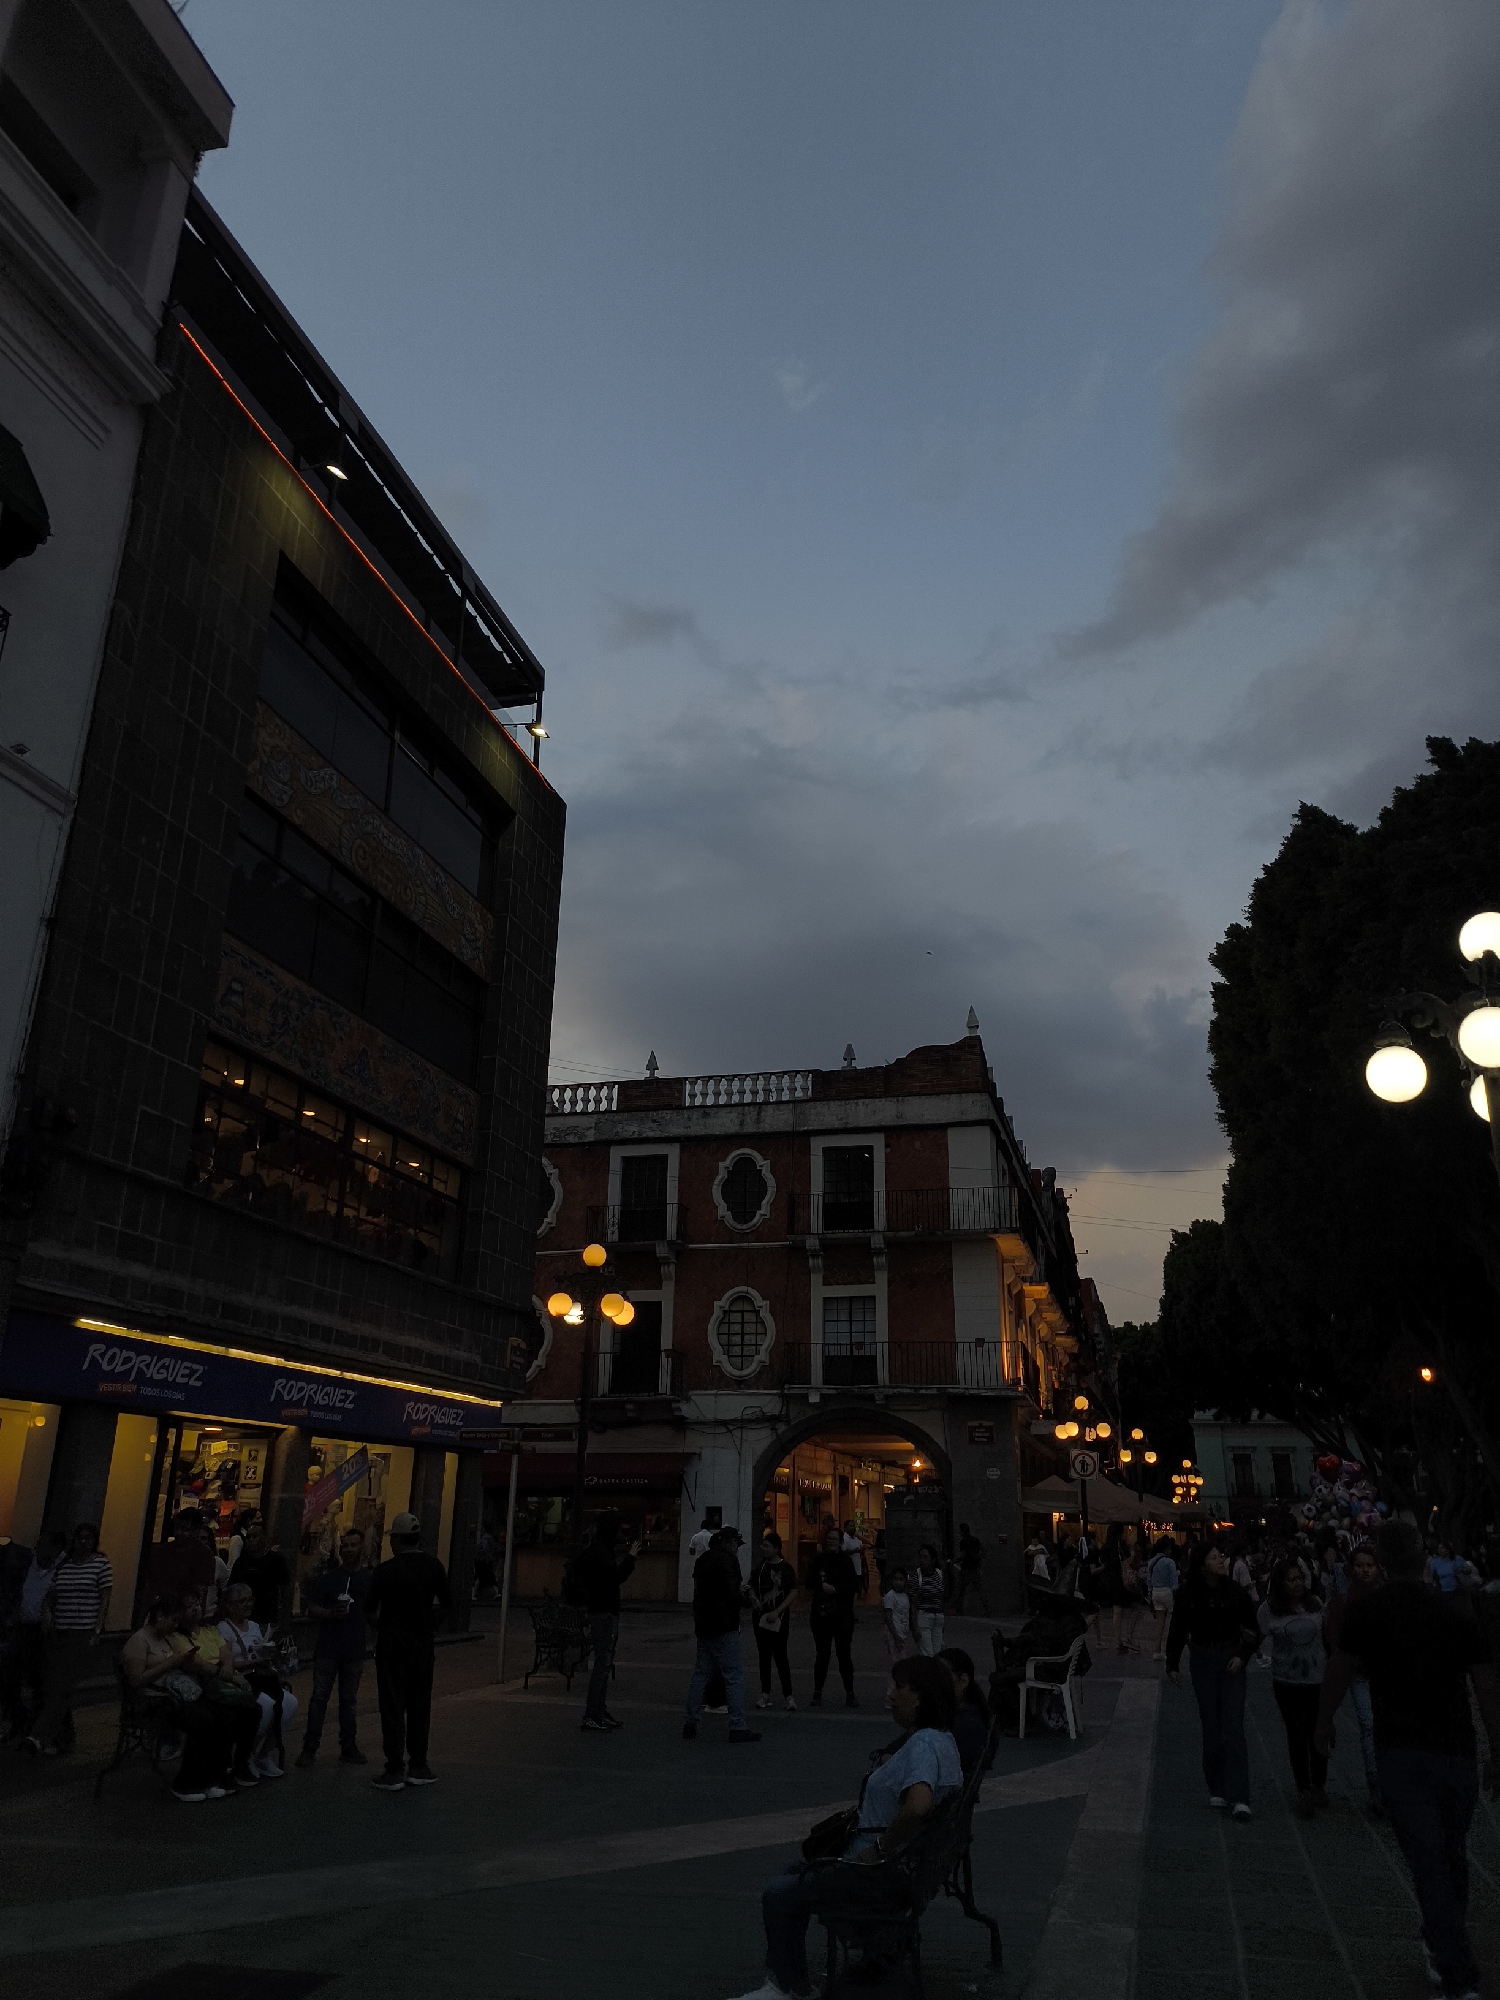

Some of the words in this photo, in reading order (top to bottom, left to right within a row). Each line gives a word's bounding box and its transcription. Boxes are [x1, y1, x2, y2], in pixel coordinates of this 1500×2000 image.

[82, 1343, 203, 1387] RODRIGUEZ
[98, 1383, 122, 1392] VESTIR
[121, 1384, 137, 1393] BIEN
[139, 1386, 160, 1396] TODOS
[270, 1378, 355, 1409] RODRIGUEZ
[402, 1401, 464, 1426] RODRIGUEZ
